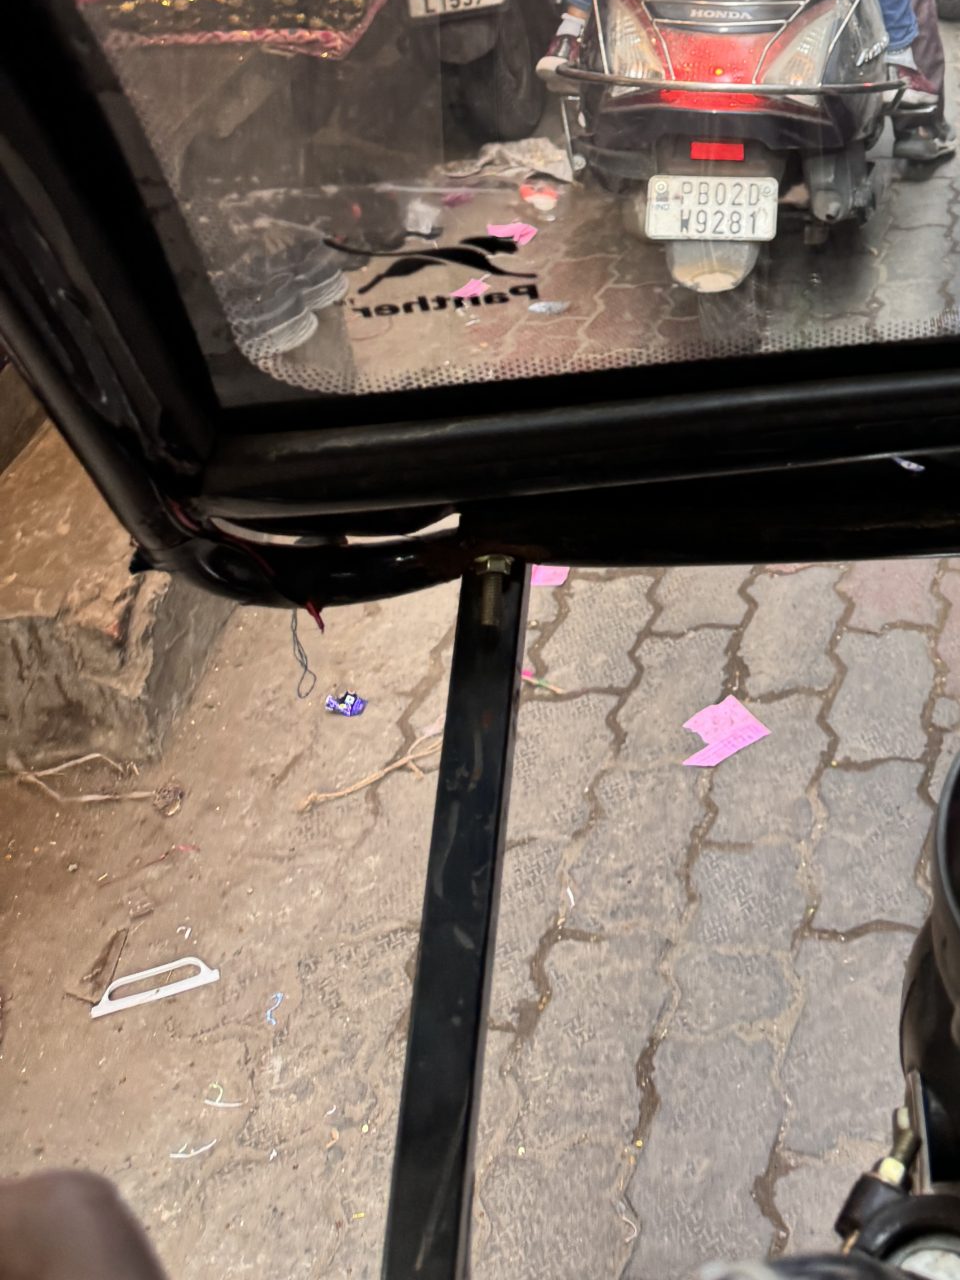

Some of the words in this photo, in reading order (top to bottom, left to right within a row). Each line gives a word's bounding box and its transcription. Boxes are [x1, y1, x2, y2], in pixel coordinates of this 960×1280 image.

[690, 8, 753, 20] HONDA
[680, 181, 760, 207] PB02D
[680, 209, 758, 235] W9281
